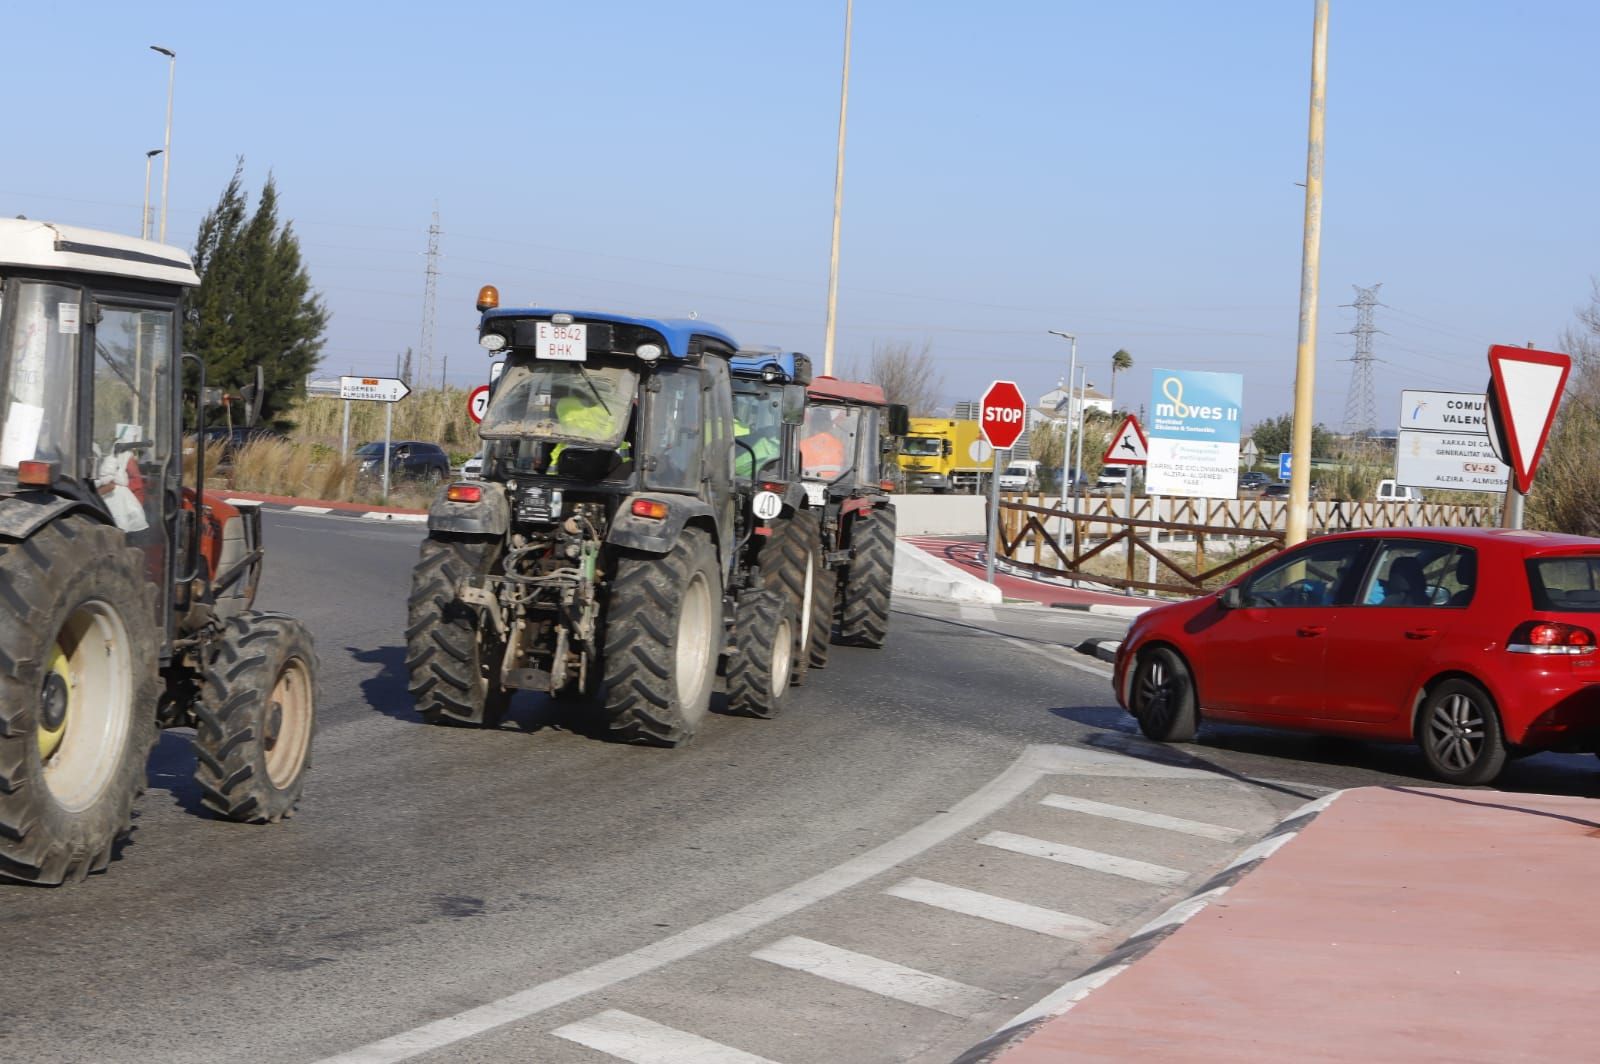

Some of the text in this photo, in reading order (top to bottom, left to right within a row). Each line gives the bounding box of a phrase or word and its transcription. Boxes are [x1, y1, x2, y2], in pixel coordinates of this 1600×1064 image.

[540, 326, 581, 341] E 8642
[549, 343, 572, 356] BHK
[477, 399, 485, 411] 7
[985, 407, 1022, 423] STOP
[1436, 449, 1480, 457] GENERALITAT
[1463, 463, 1496, 473] CV-42
[1436, 475, 1464, 483] ALZIRA
[759, 494, 775, 517] 40
